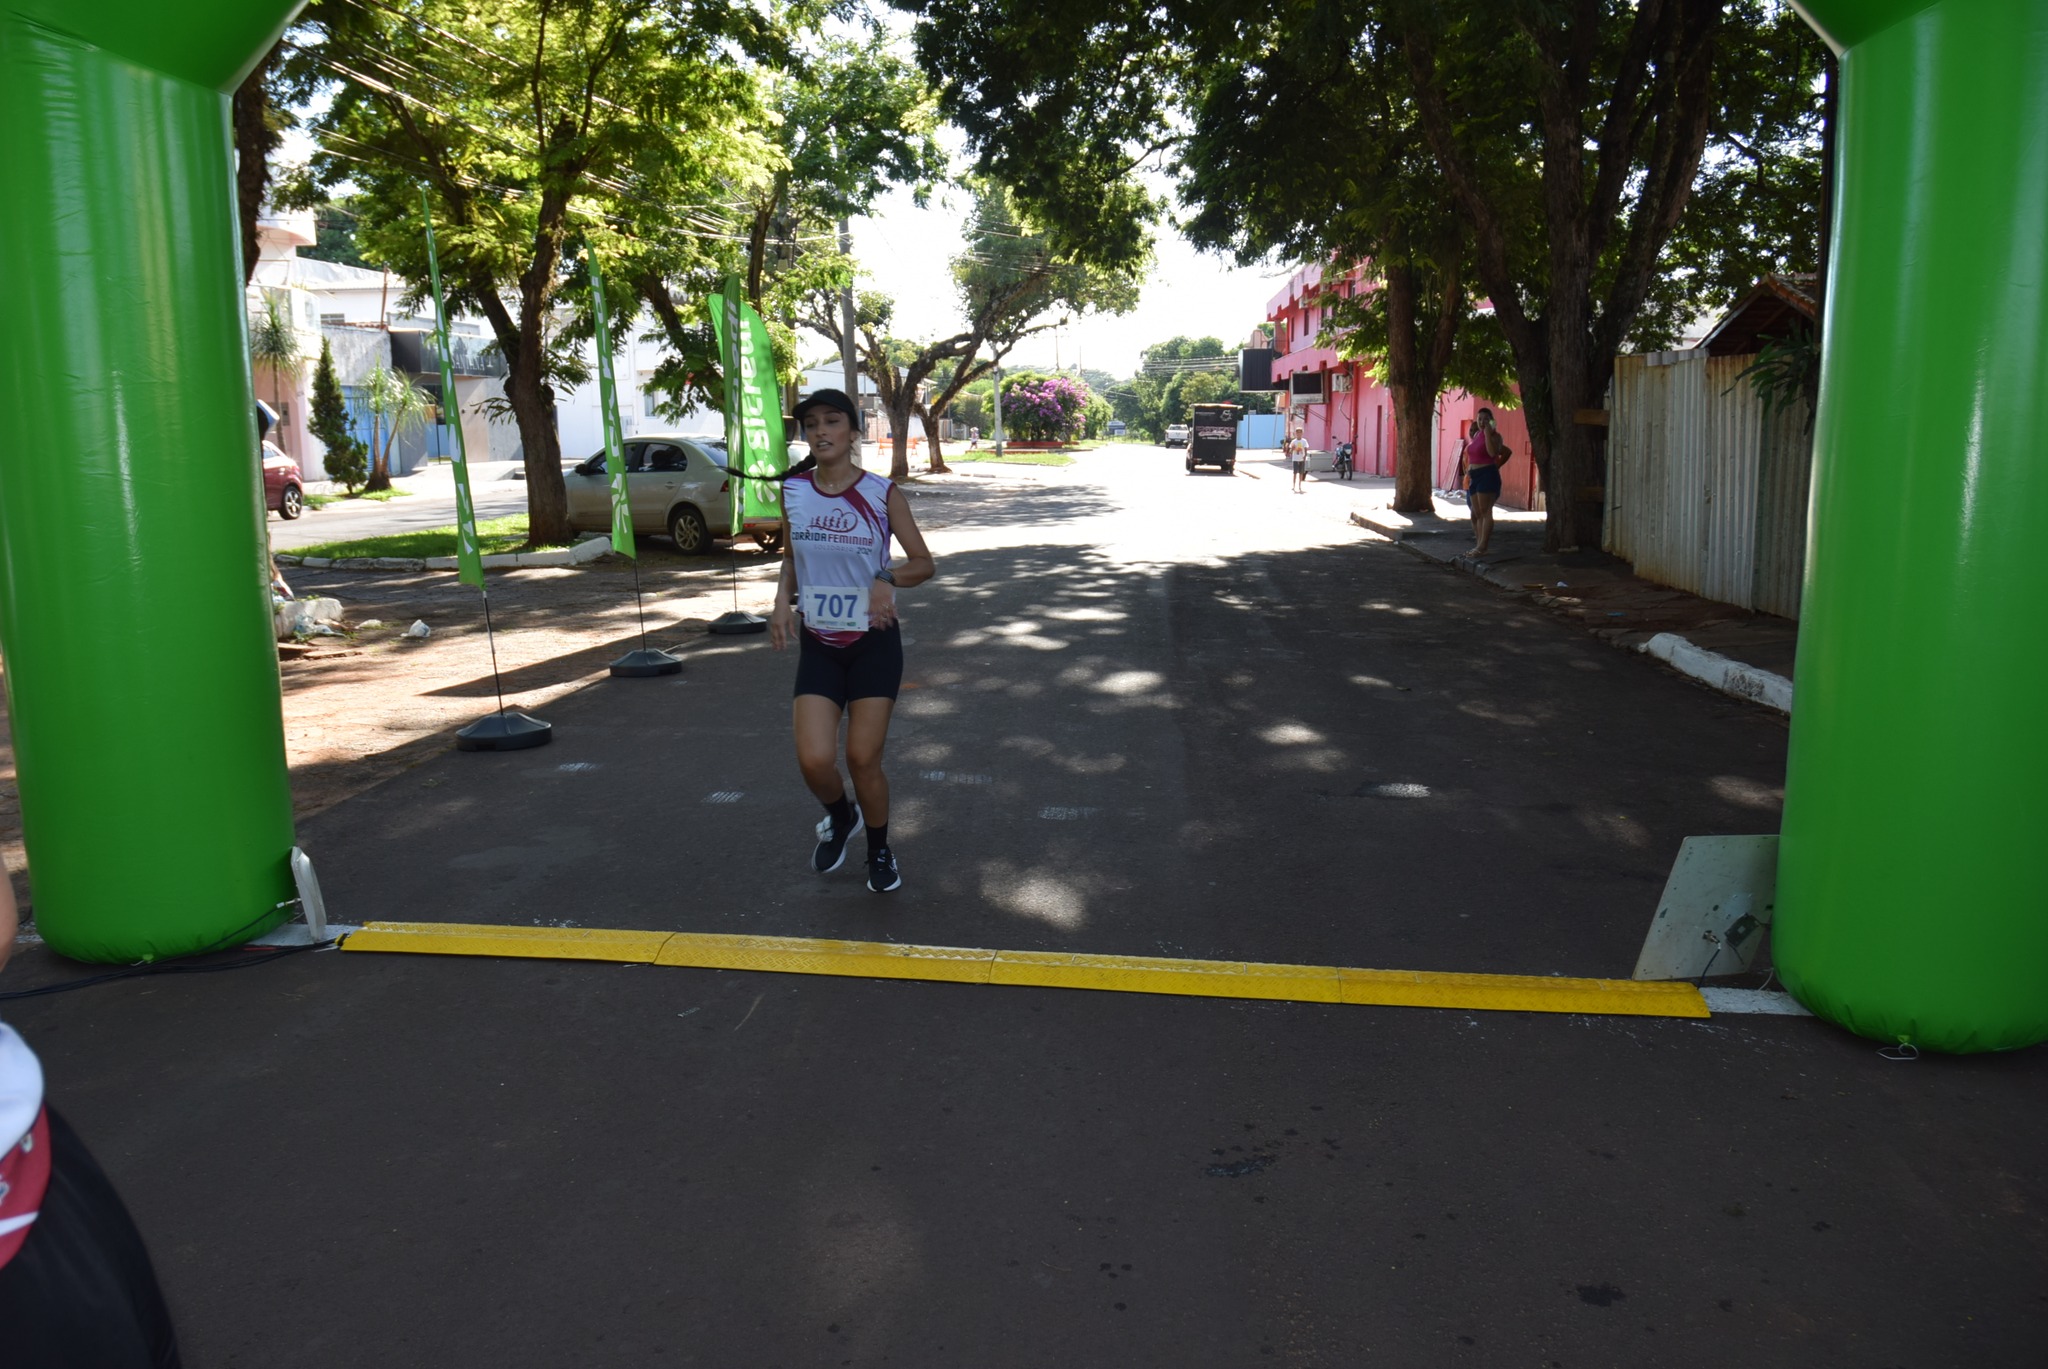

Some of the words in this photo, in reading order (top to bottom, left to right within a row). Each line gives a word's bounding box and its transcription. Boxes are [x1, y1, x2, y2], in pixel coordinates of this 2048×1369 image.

[791, 532, 827, 542] CORRIDA
[828, 533, 873, 546] FEMININA
[814, 593, 858, 618] 707
